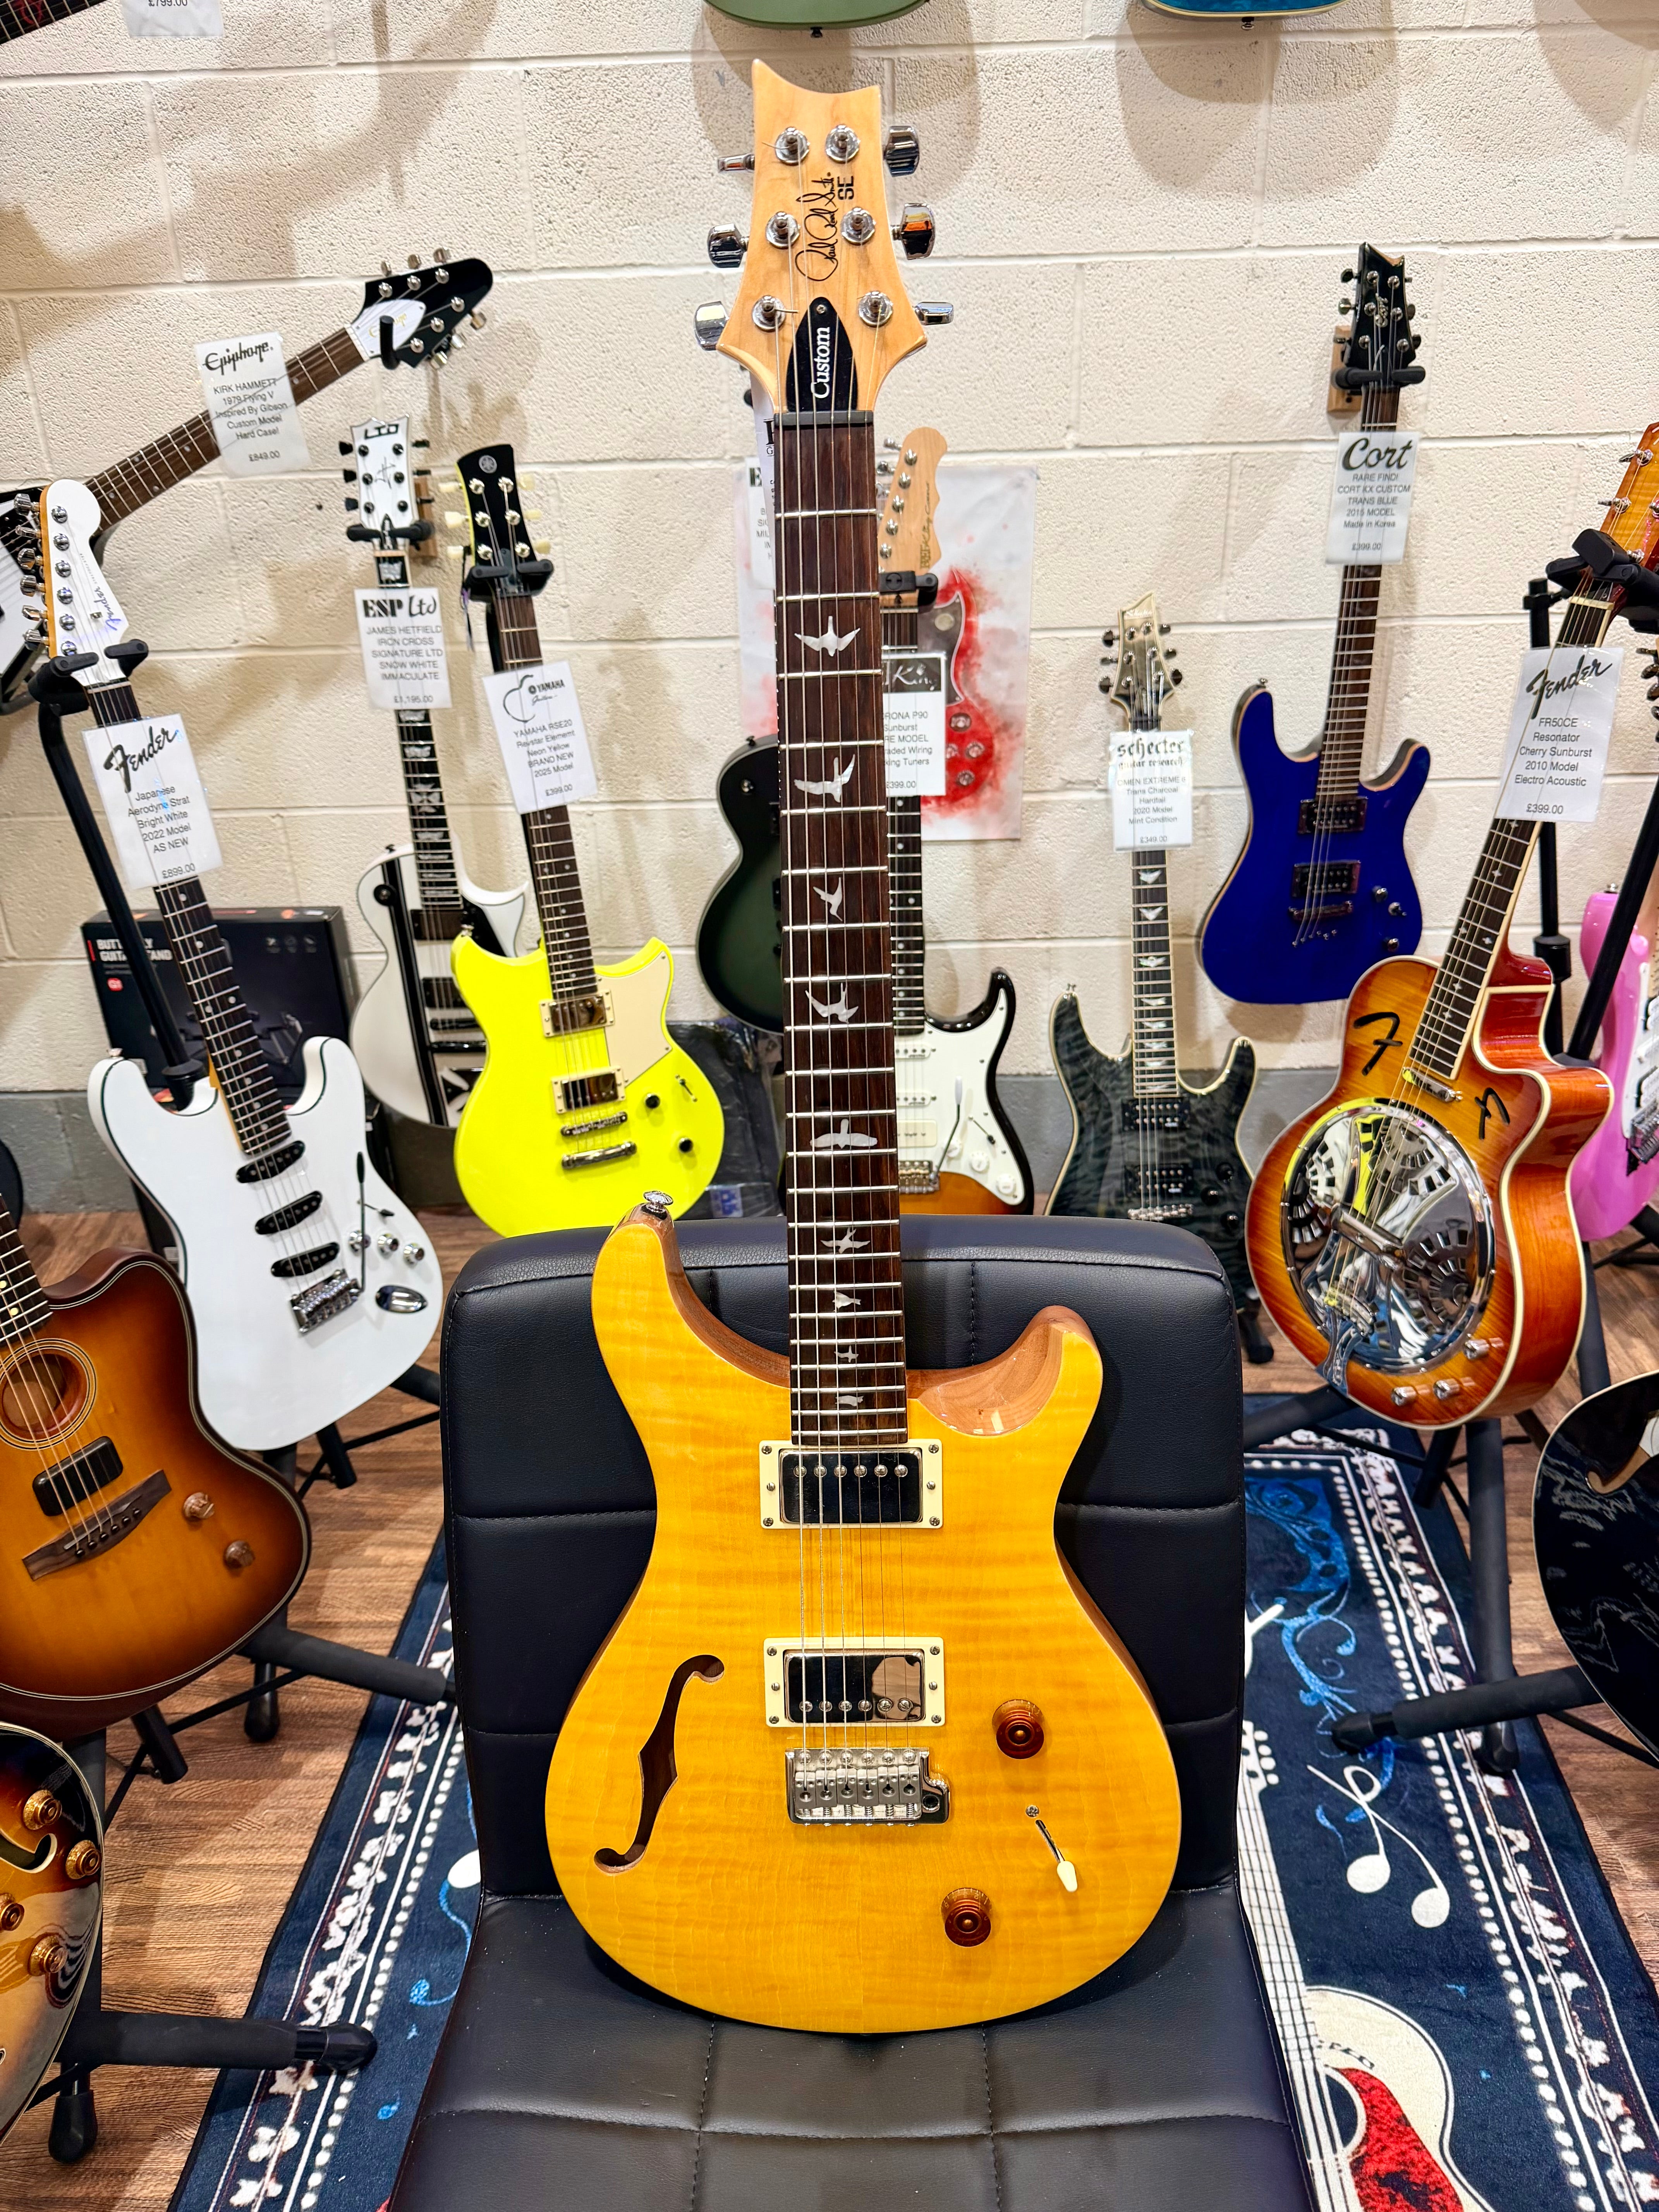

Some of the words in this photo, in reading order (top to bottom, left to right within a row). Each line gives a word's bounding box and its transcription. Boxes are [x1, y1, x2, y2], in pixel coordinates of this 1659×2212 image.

[837, 176, 854, 200] SE
[811, 327, 830, 399] Custom
[213, 384, 233, 394] KIRK
[235, 378, 276, 391] HAMMETT
[223, 395, 241, 405] 1979
[215, 407, 246, 418] Inspired
[248, 406, 258, 416] By
[259, 402, 288, 412] Gibson
[227, 419, 256, 429] Custom
[258, 414, 282, 425] Model
[235, 430, 255, 440] Hard
[364, 424, 399, 440] LTD
[1342, 438, 1413, 471] Cort
[1352, 473, 1375, 482] RARE
[1337, 486, 1361, 494] CORT
[1376, 485, 1411, 493] CUSTOM
[1348, 497, 1374, 505] TRANS
[1377, 496, 1398, 505] BLUE
[1367, 508, 1395, 516] MODEL
[1343, 520, 1363, 528] Made
[1365, 520, 1372, 528] in
[1374, 519, 1395, 528] Korea
[94, 586, 121, 631] Fender
[362, 599, 403, 618] ESP
[366, 626, 396, 635] JAMES
[402, 637, 434, 646] CROSS
[371, 649, 422, 658] SIGNATURE
[426, 649, 443, 657] LTD
[379, 661, 407, 670] SNOW
[381, 672, 439, 680] IMMACULATE
[537, 679, 565, 693] YAMAHA
[1526, 654, 1613, 720] Fender
[884, 712, 910, 720] RONA
[912, 711, 929, 719] P90
[1538, 718, 1578, 728] FR50CE
[514, 725, 547, 737] YAMAHA
[1533, 732, 1580, 742] Resonator
[898, 734, 929, 742] MODEL
[527, 746, 546, 757] Neon
[548, 742, 570, 752] Yellow
[908, 746, 933, 755] Wiring
[1519, 746, 1547, 758] Cherry
[1550, 747, 1592, 758] Sunburst
[103, 726, 179, 793] Fender
[528, 756, 555, 768] BRAND
[556, 752, 574, 762] NEW
[886, 758, 900, 768] king
[554, 762, 574, 773] Model
[1525, 761, 1548, 771] 2010
[1550, 761, 1578, 771] Model
[1515, 775, 1544, 785] Electro
[1546, 776, 1587, 787] Acoustic
[135, 785, 175, 801] Japanese
[128, 802, 168, 817] Aerodyne
[170, 795, 191, 807] Strat
[1526, 804, 1563, 814] £399.00
[138, 816, 164, 830] Bright
[166, 811, 188, 822] White
[1145, 816, 1177, 824] Condition
[142, 829, 165, 842] 2022
[167, 823, 191, 836] Model
[153, 843, 166, 854] AS
[168, 837, 189, 850] NEW
[162, 862, 196, 879] £899.00
